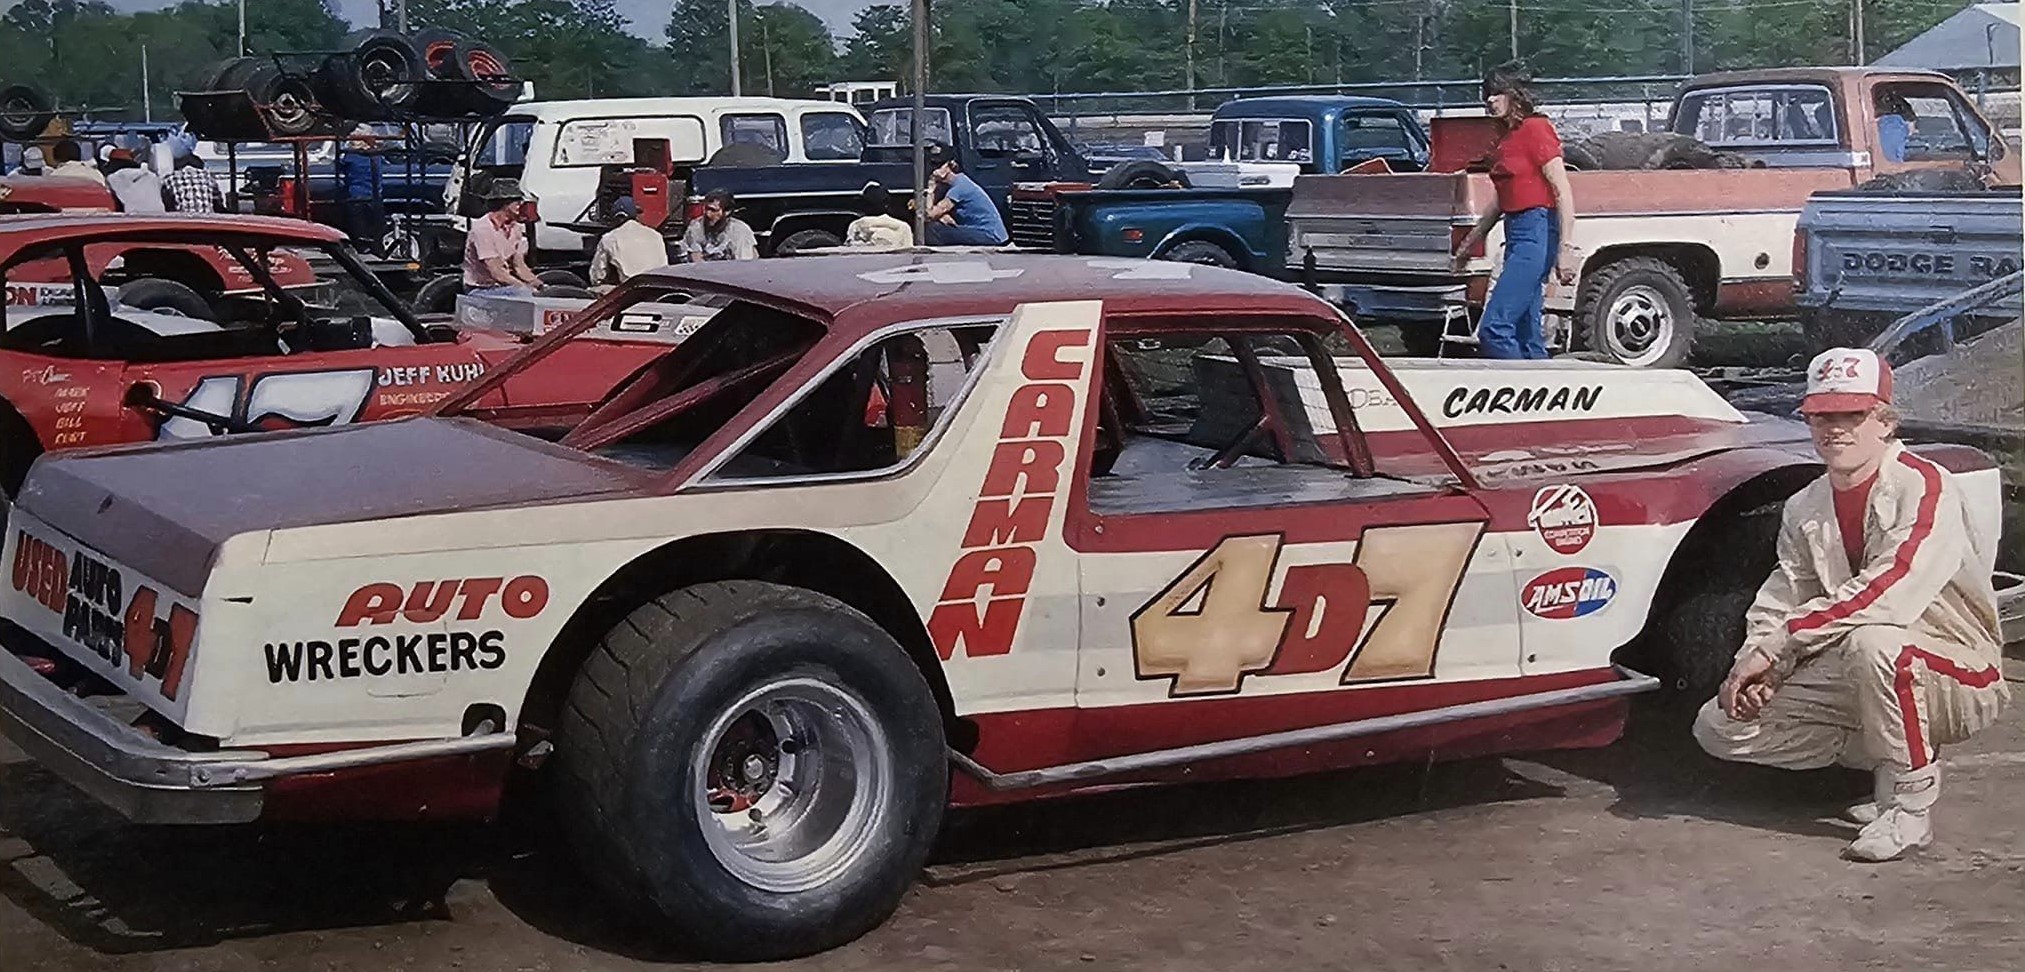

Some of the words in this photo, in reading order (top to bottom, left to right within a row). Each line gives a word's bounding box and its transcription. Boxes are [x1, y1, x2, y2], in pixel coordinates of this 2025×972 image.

[1842, 252, 1954, 273] DODGE
[378, 366, 430, 386] JEFF
[1443, 386, 1603, 418] CARMAN
[927, 329, 1091, 661] CARMAN
[12, 529, 68, 614] USED
[68, 550, 122, 616] AUTO
[1526, 577, 1614, 613] AMSOIL
[334, 575, 549, 627] AUTO
[1129, 519, 1490, 698] 4D7
[123, 584, 199, 702] 4D7
[264, 631, 506, 683] WRECKERS
